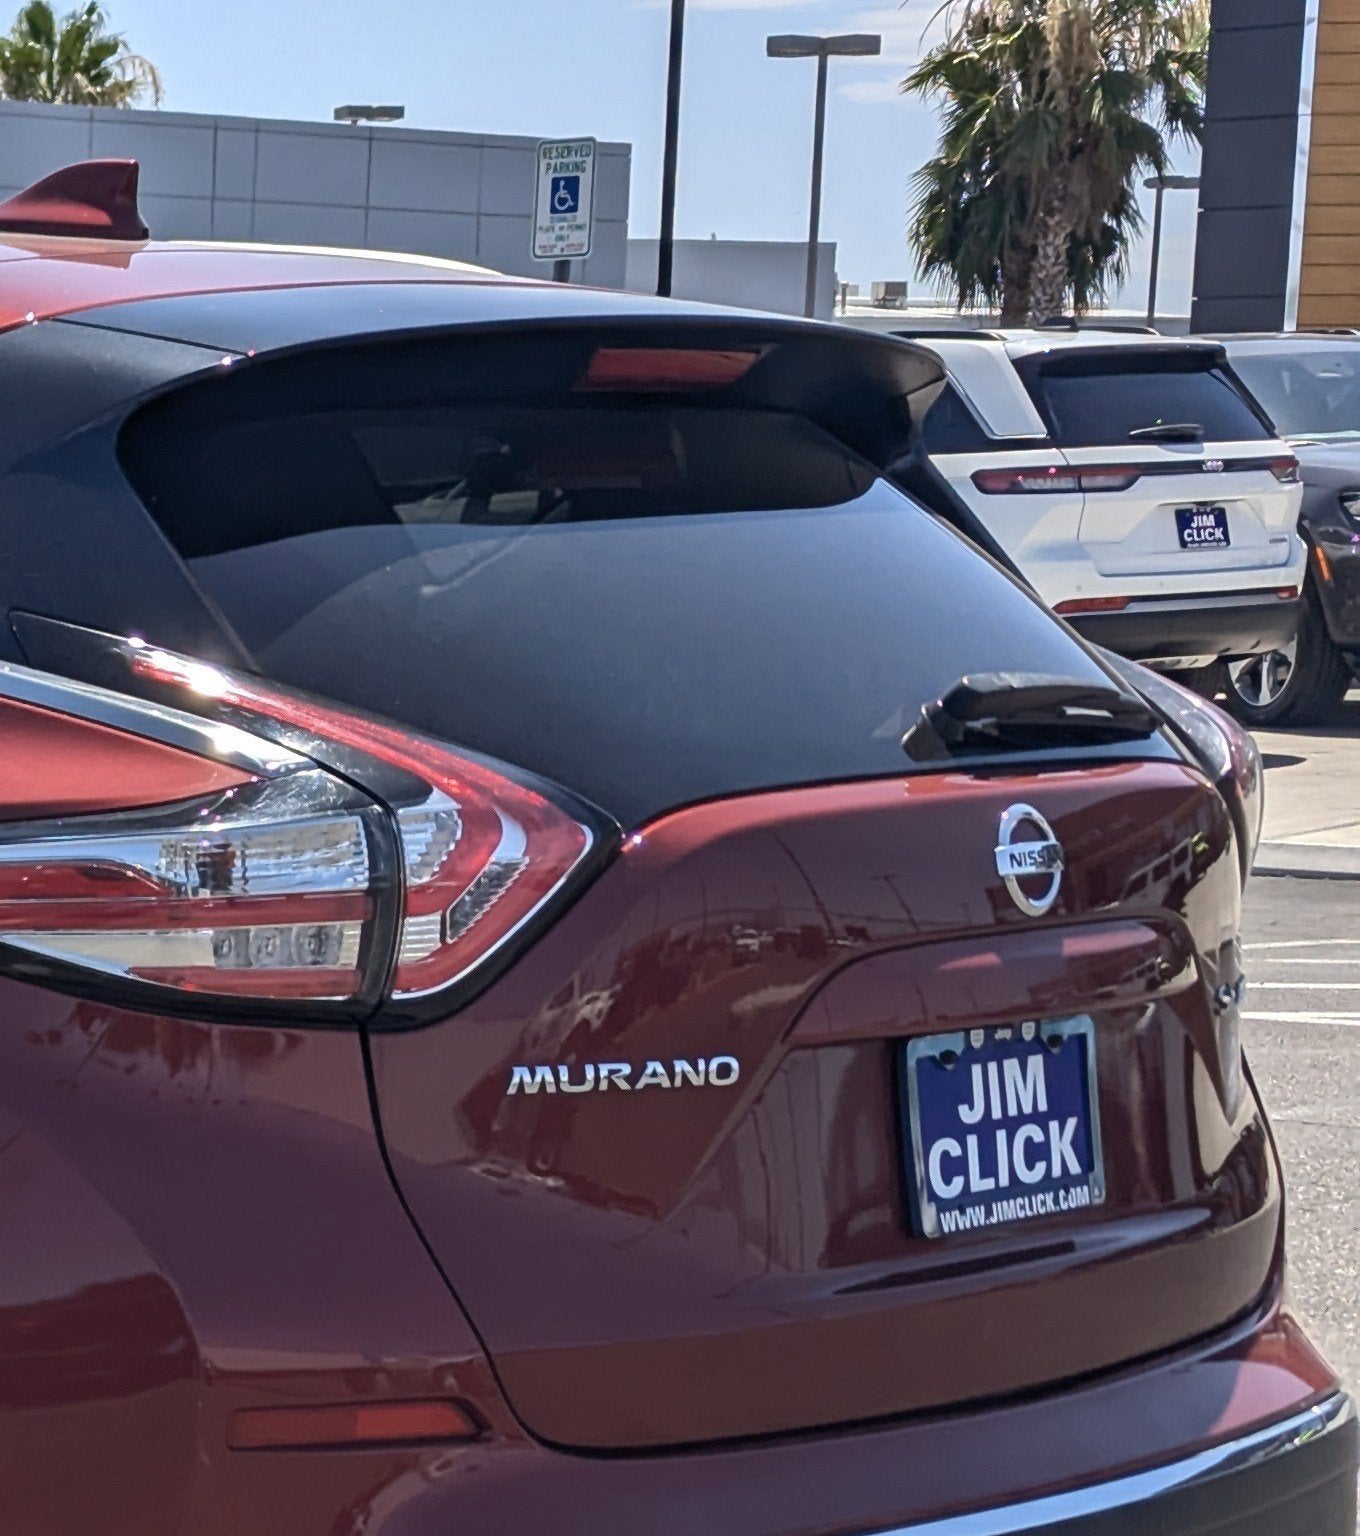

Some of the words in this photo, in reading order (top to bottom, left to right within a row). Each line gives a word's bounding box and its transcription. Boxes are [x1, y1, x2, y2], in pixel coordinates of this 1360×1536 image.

[545, 160, 587, 174] PARKING
[1183, 527, 1225, 542] CLICK
[1191, 514, 1216, 528] JIM
[506, 1055, 741, 1096] MURANO
[957, 1053, 1049, 1125] JIM
[928, 1116, 1083, 1199] CLICK
[939, 1184, 1090, 1234] WWW.JIMCLICK.COM
